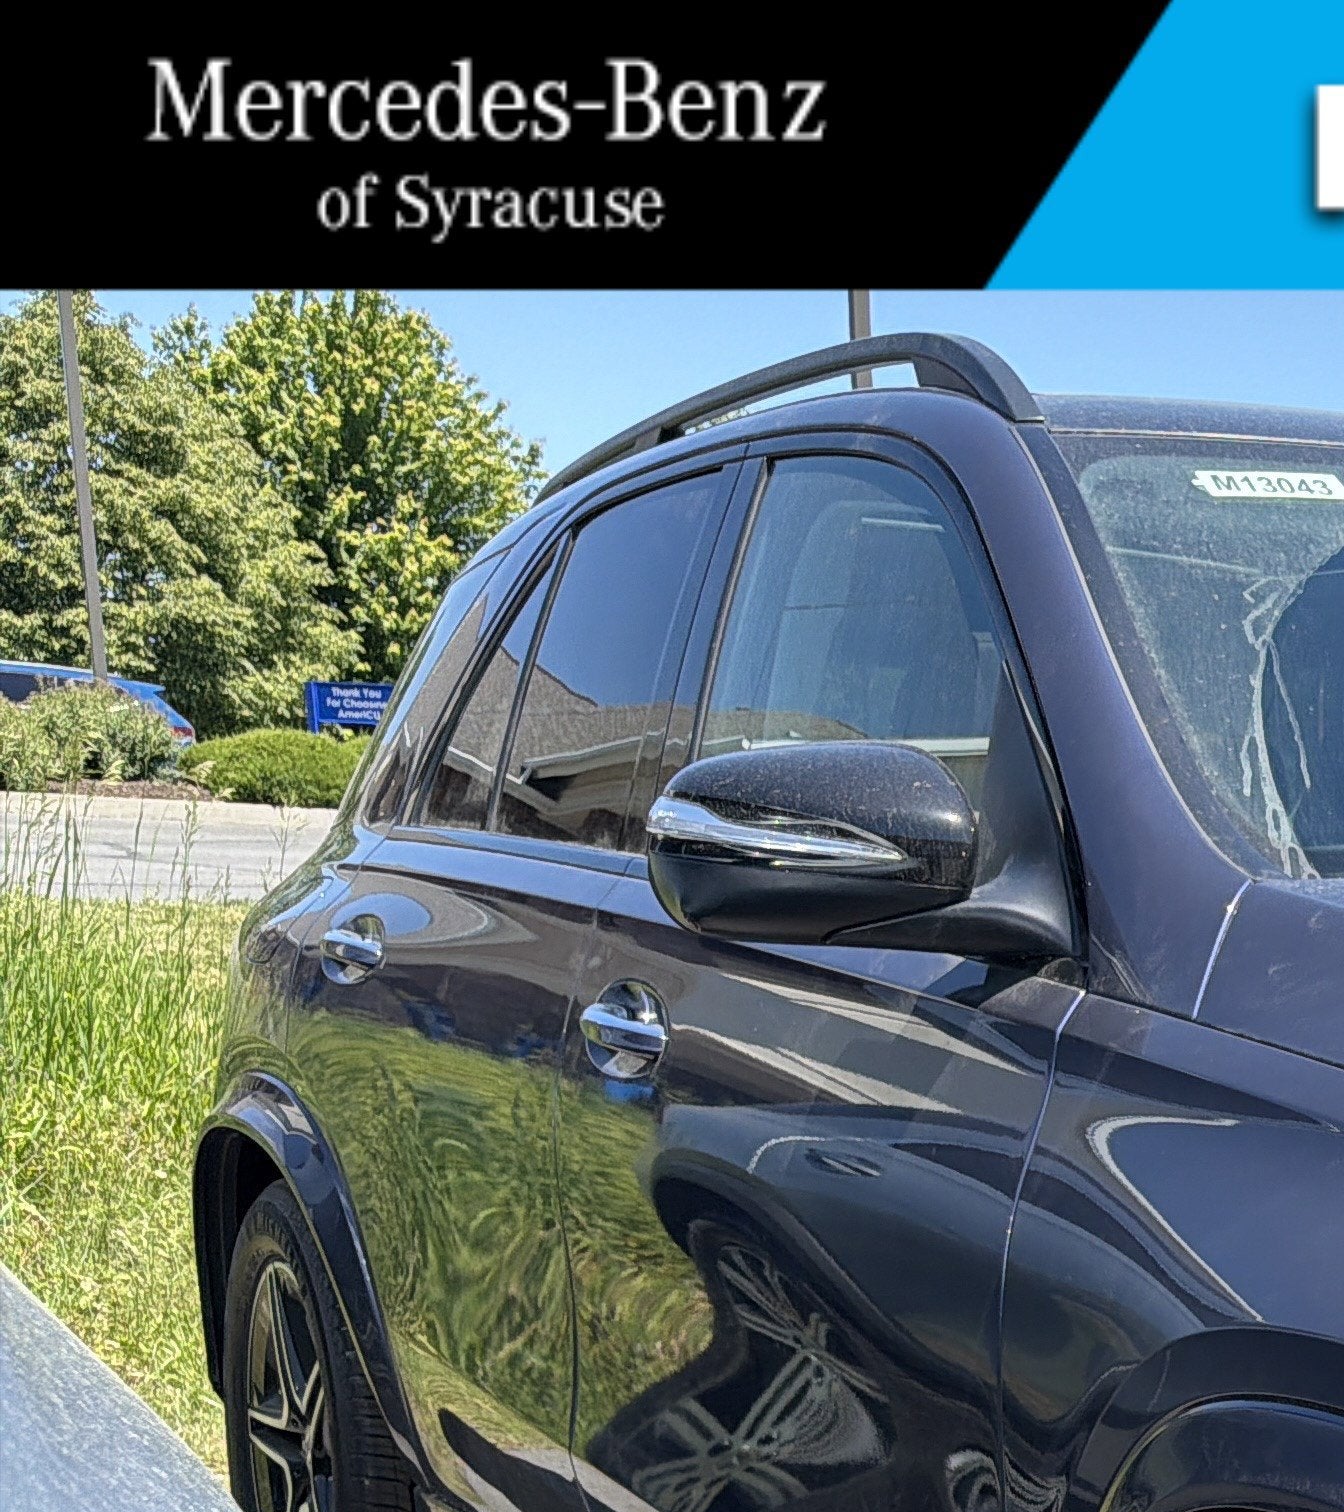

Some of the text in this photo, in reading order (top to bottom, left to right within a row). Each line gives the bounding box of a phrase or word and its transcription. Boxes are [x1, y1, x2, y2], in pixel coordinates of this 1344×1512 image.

[1210, 474, 1333, 496] M13043
[331, 687, 382, 698] Thank You
